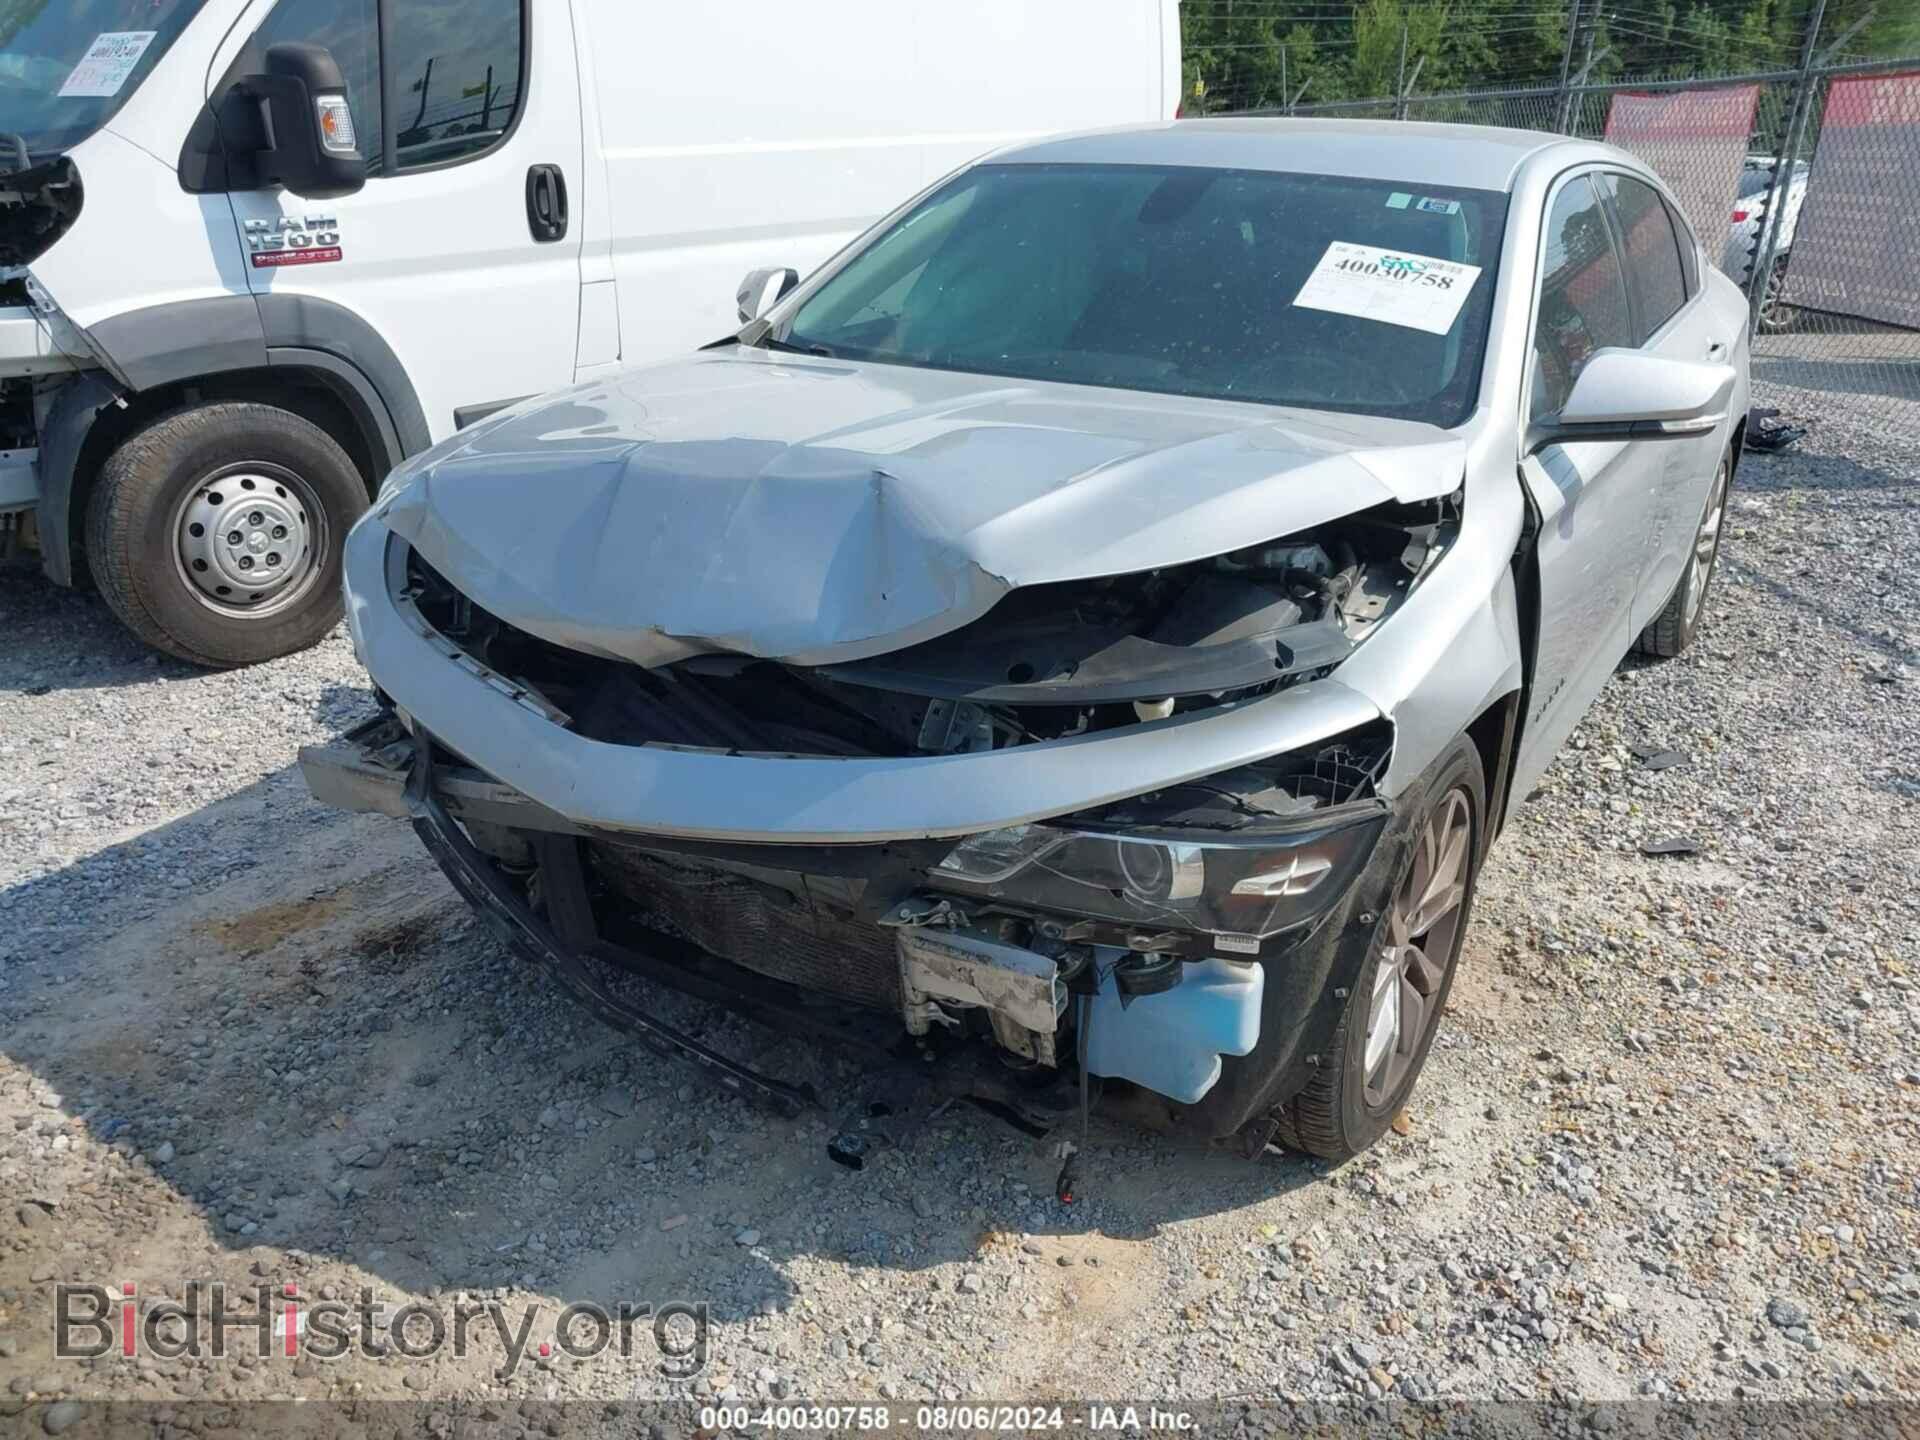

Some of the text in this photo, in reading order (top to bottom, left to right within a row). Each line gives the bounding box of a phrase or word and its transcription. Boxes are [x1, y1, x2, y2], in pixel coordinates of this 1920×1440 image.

[243, 215, 338, 233] RAM
[247, 232, 341, 251] 1500
[1334, 258, 1455, 290] 40030758
